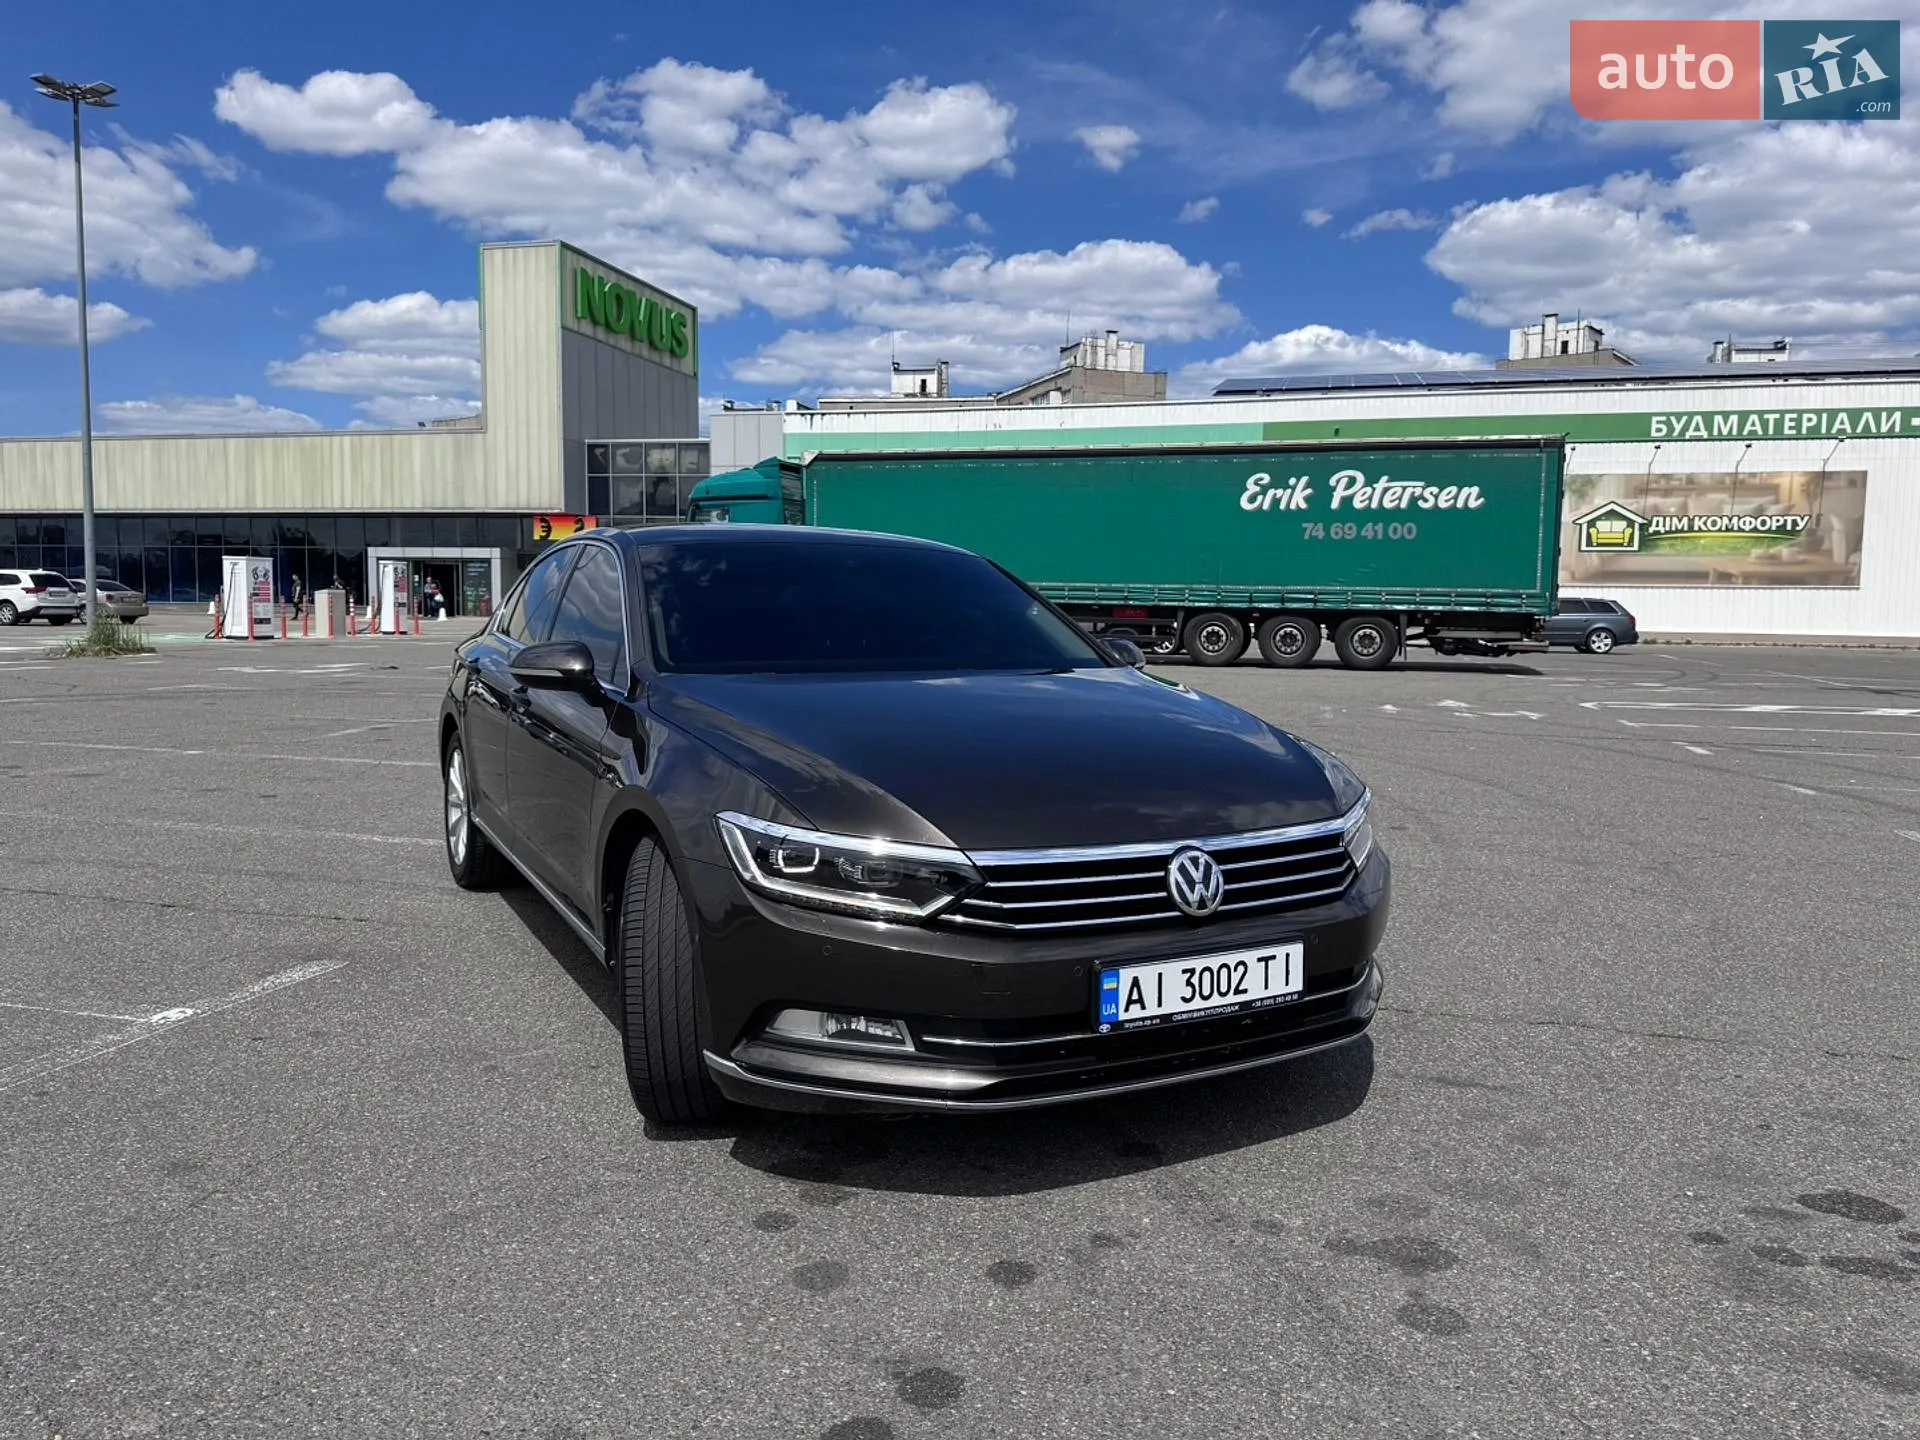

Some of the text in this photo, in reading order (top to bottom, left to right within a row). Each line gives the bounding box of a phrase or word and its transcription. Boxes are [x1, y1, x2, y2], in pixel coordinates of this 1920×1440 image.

[575, 266, 689, 358] NOVUS
[1650, 411, 1902, 439] БУДМАТЕРІАЛИ
[1239, 469, 1485, 511] Erik Petersen
[1302, 522, 1418, 540] 74 69 41 00
[1648, 514, 1811, 533] ДІМ КОМФОРТУ
[1124, 952, 1290, 1013] AI 3002 TI
[1102, 1003, 1117, 1015] UA
